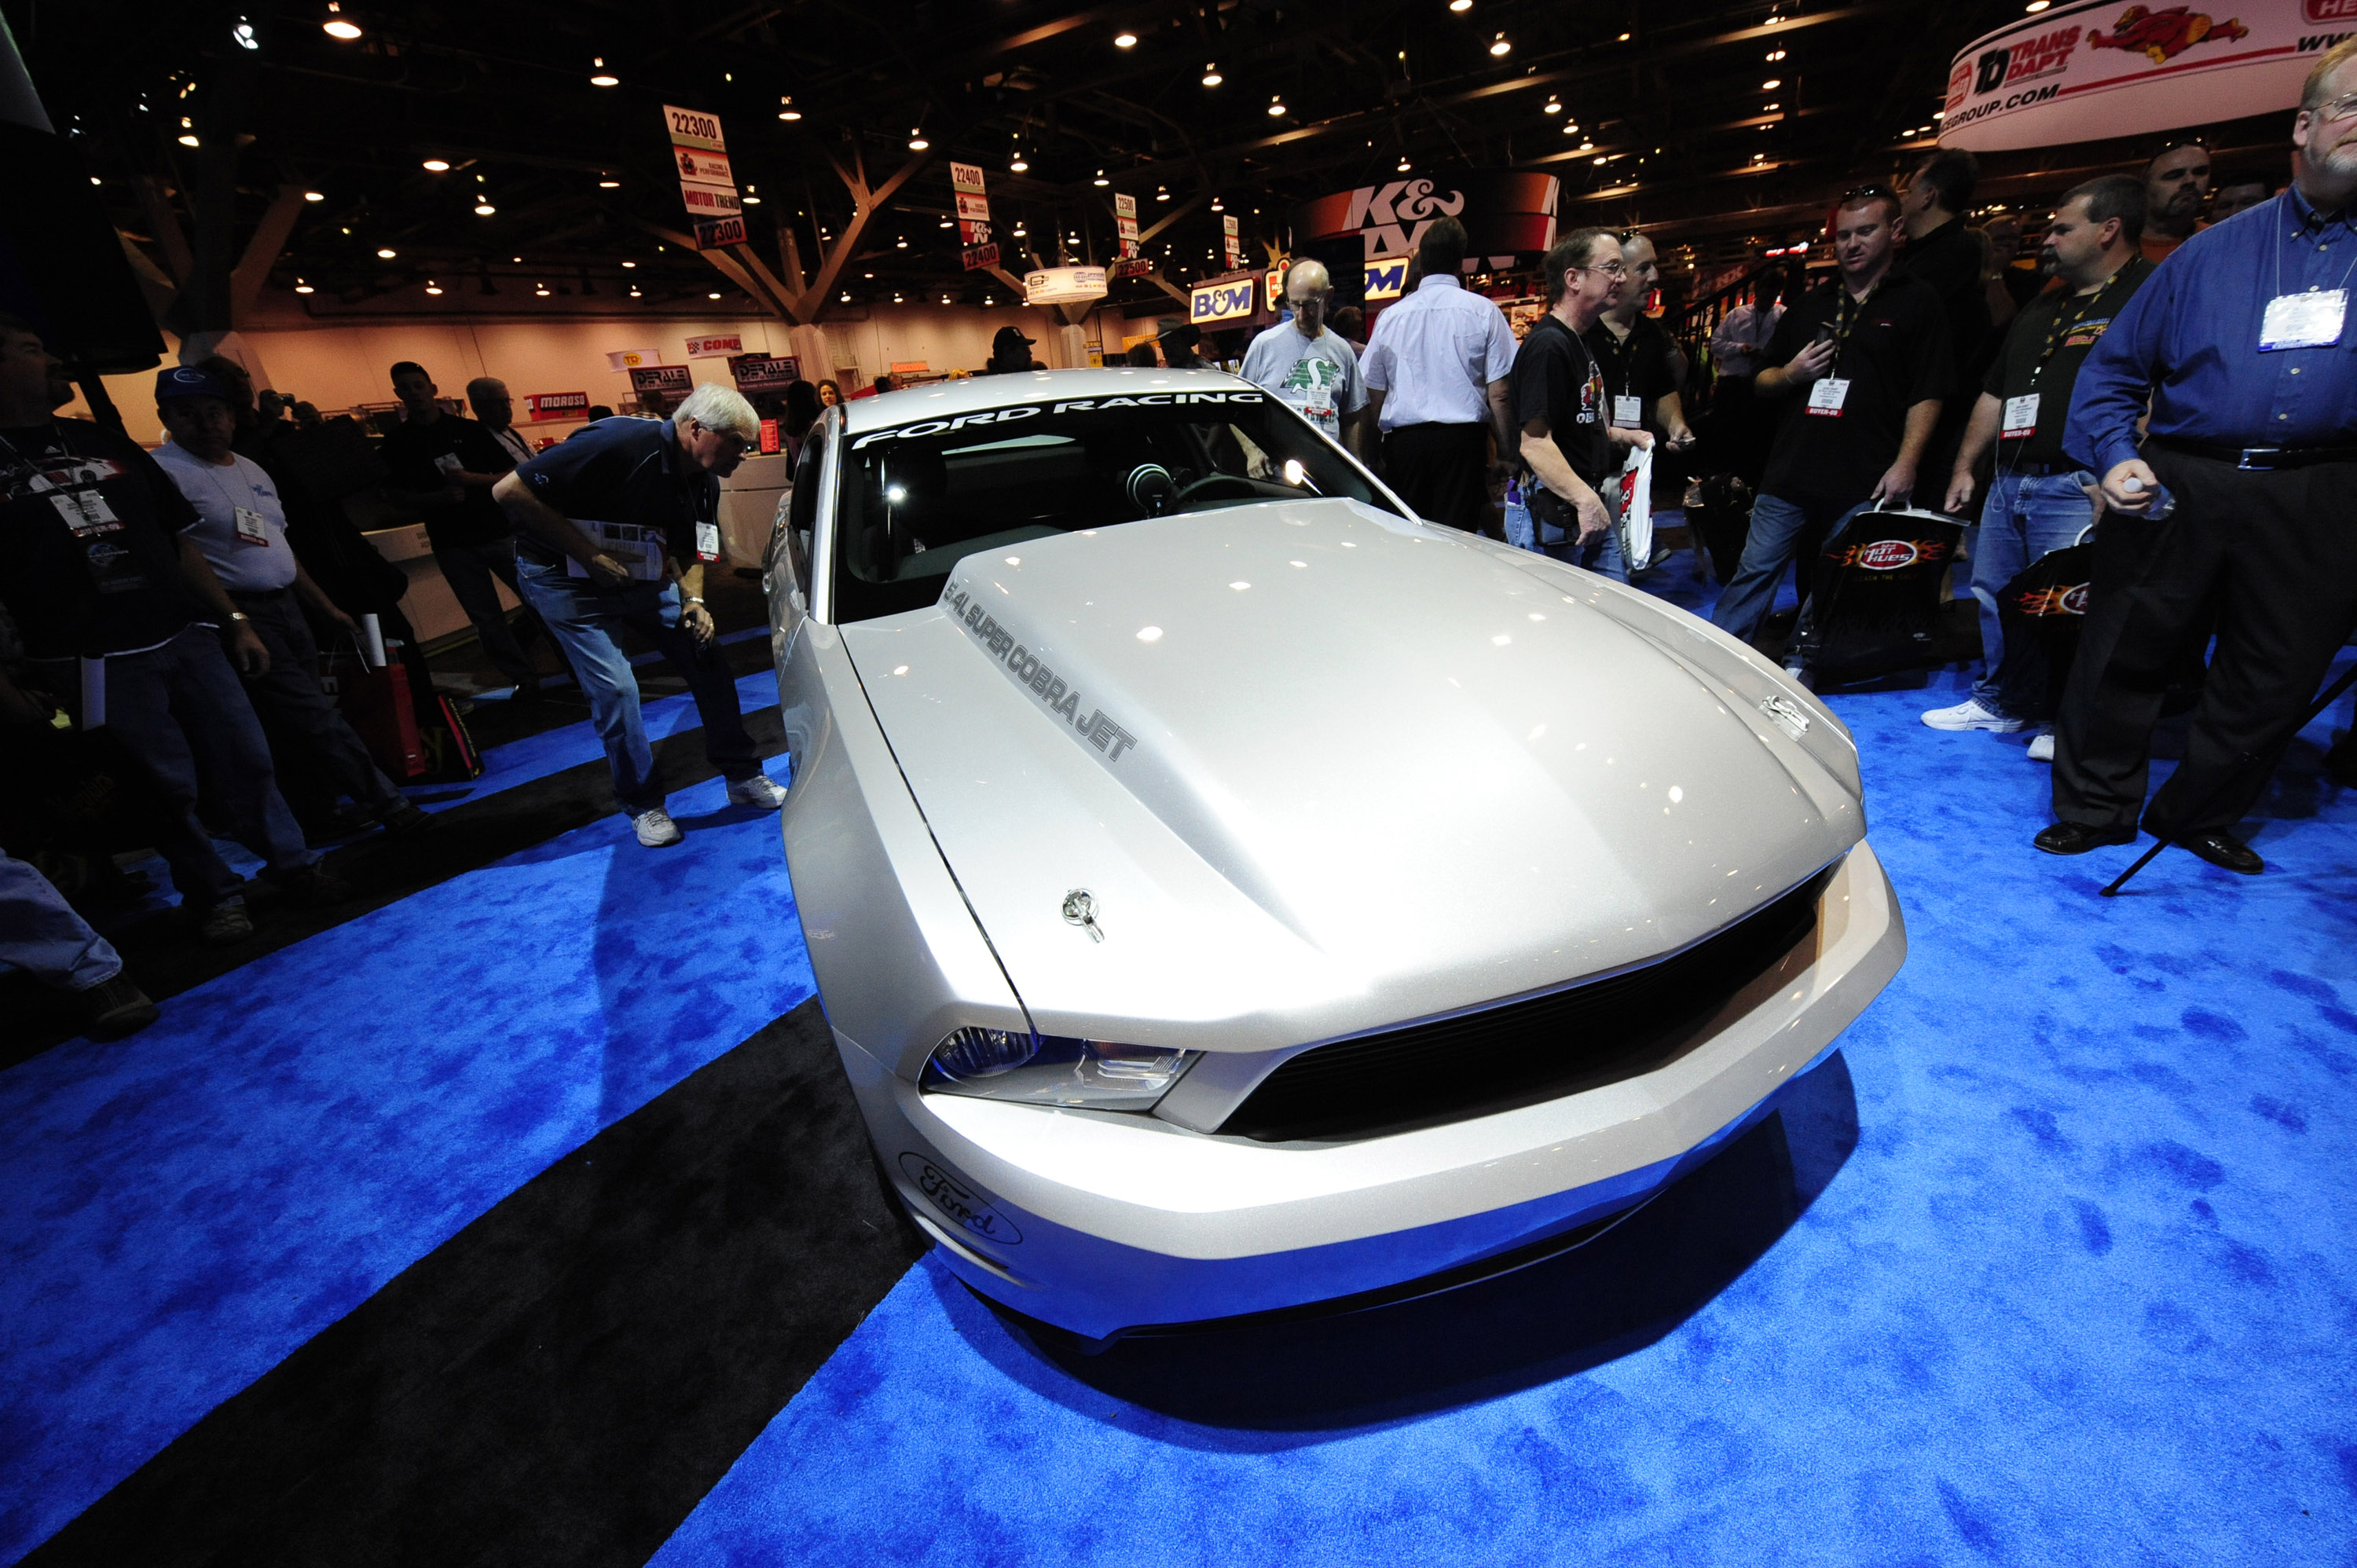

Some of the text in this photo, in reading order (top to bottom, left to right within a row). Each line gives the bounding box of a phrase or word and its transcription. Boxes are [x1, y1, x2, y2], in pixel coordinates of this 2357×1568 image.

[2010, 25, 2082, 77] TRANS
[2006, 47, 2075, 82] DAPT
[673, 112, 717, 139] 22300
[955, 167, 981, 185] 22400
[684, 189, 740, 210] MOTOR TREND
[1118, 196, 1134, 211] 22500
[698, 220, 742, 244] 22300
[966, 246, 996, 267] 22400
[1118, 261, 1146, 277] 22500
[1193, 285, 1252, 318] B&M
[703, 339, 739, 350] COMP
[636, 370, 686, 384] DERALE
[739, 361, 793, 376] DERALE
[541, 395, 585, 408] MOROSO
[851, 393, 1263, 449] FORD RACING
[964, 603, 1015, 661] SUPER
[1006, 644, 1080, 725] COBRA
[1075, 709, 1138, 763] JET
[920, 1165, 995, 1234] Ford
